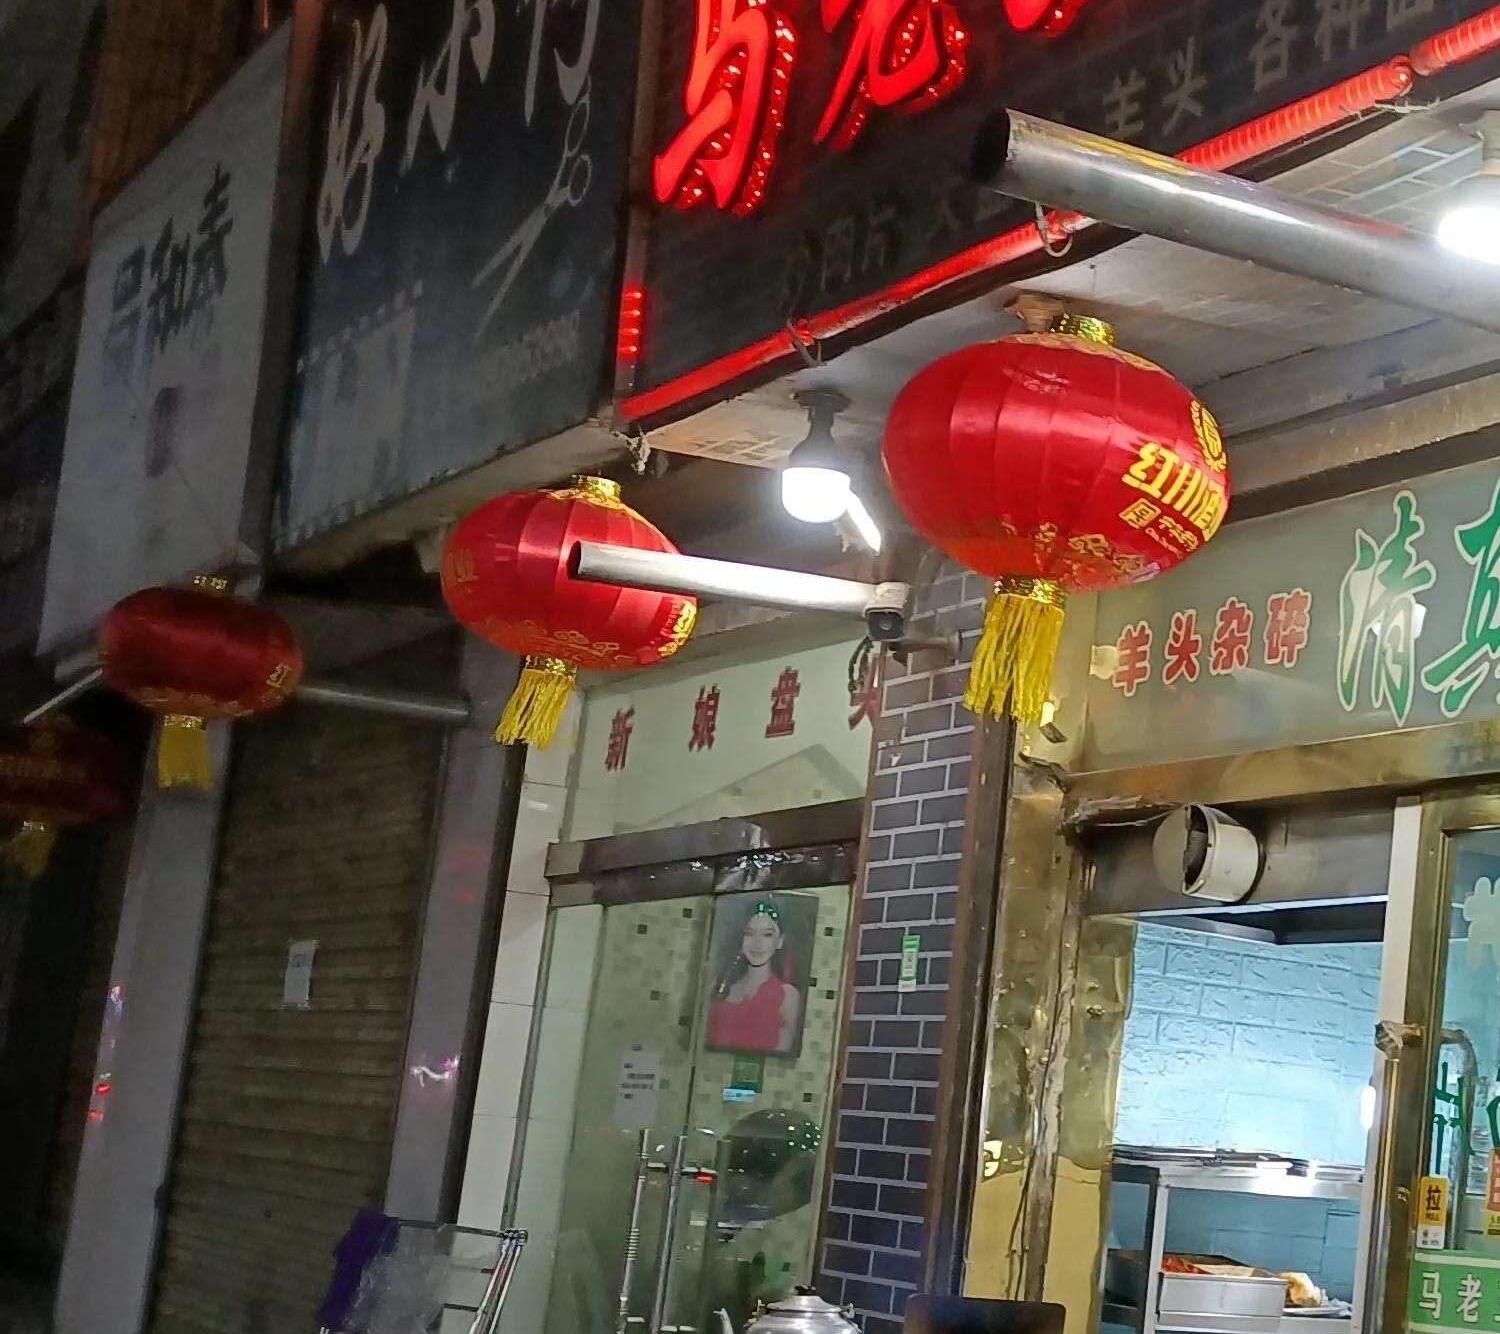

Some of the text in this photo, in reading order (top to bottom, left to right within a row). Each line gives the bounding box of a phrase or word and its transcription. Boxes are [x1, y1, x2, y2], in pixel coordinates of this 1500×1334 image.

[1112, 588, 1312, 698] 羊头杂碎
[1425, 1183, 1442, 1211] 拉
